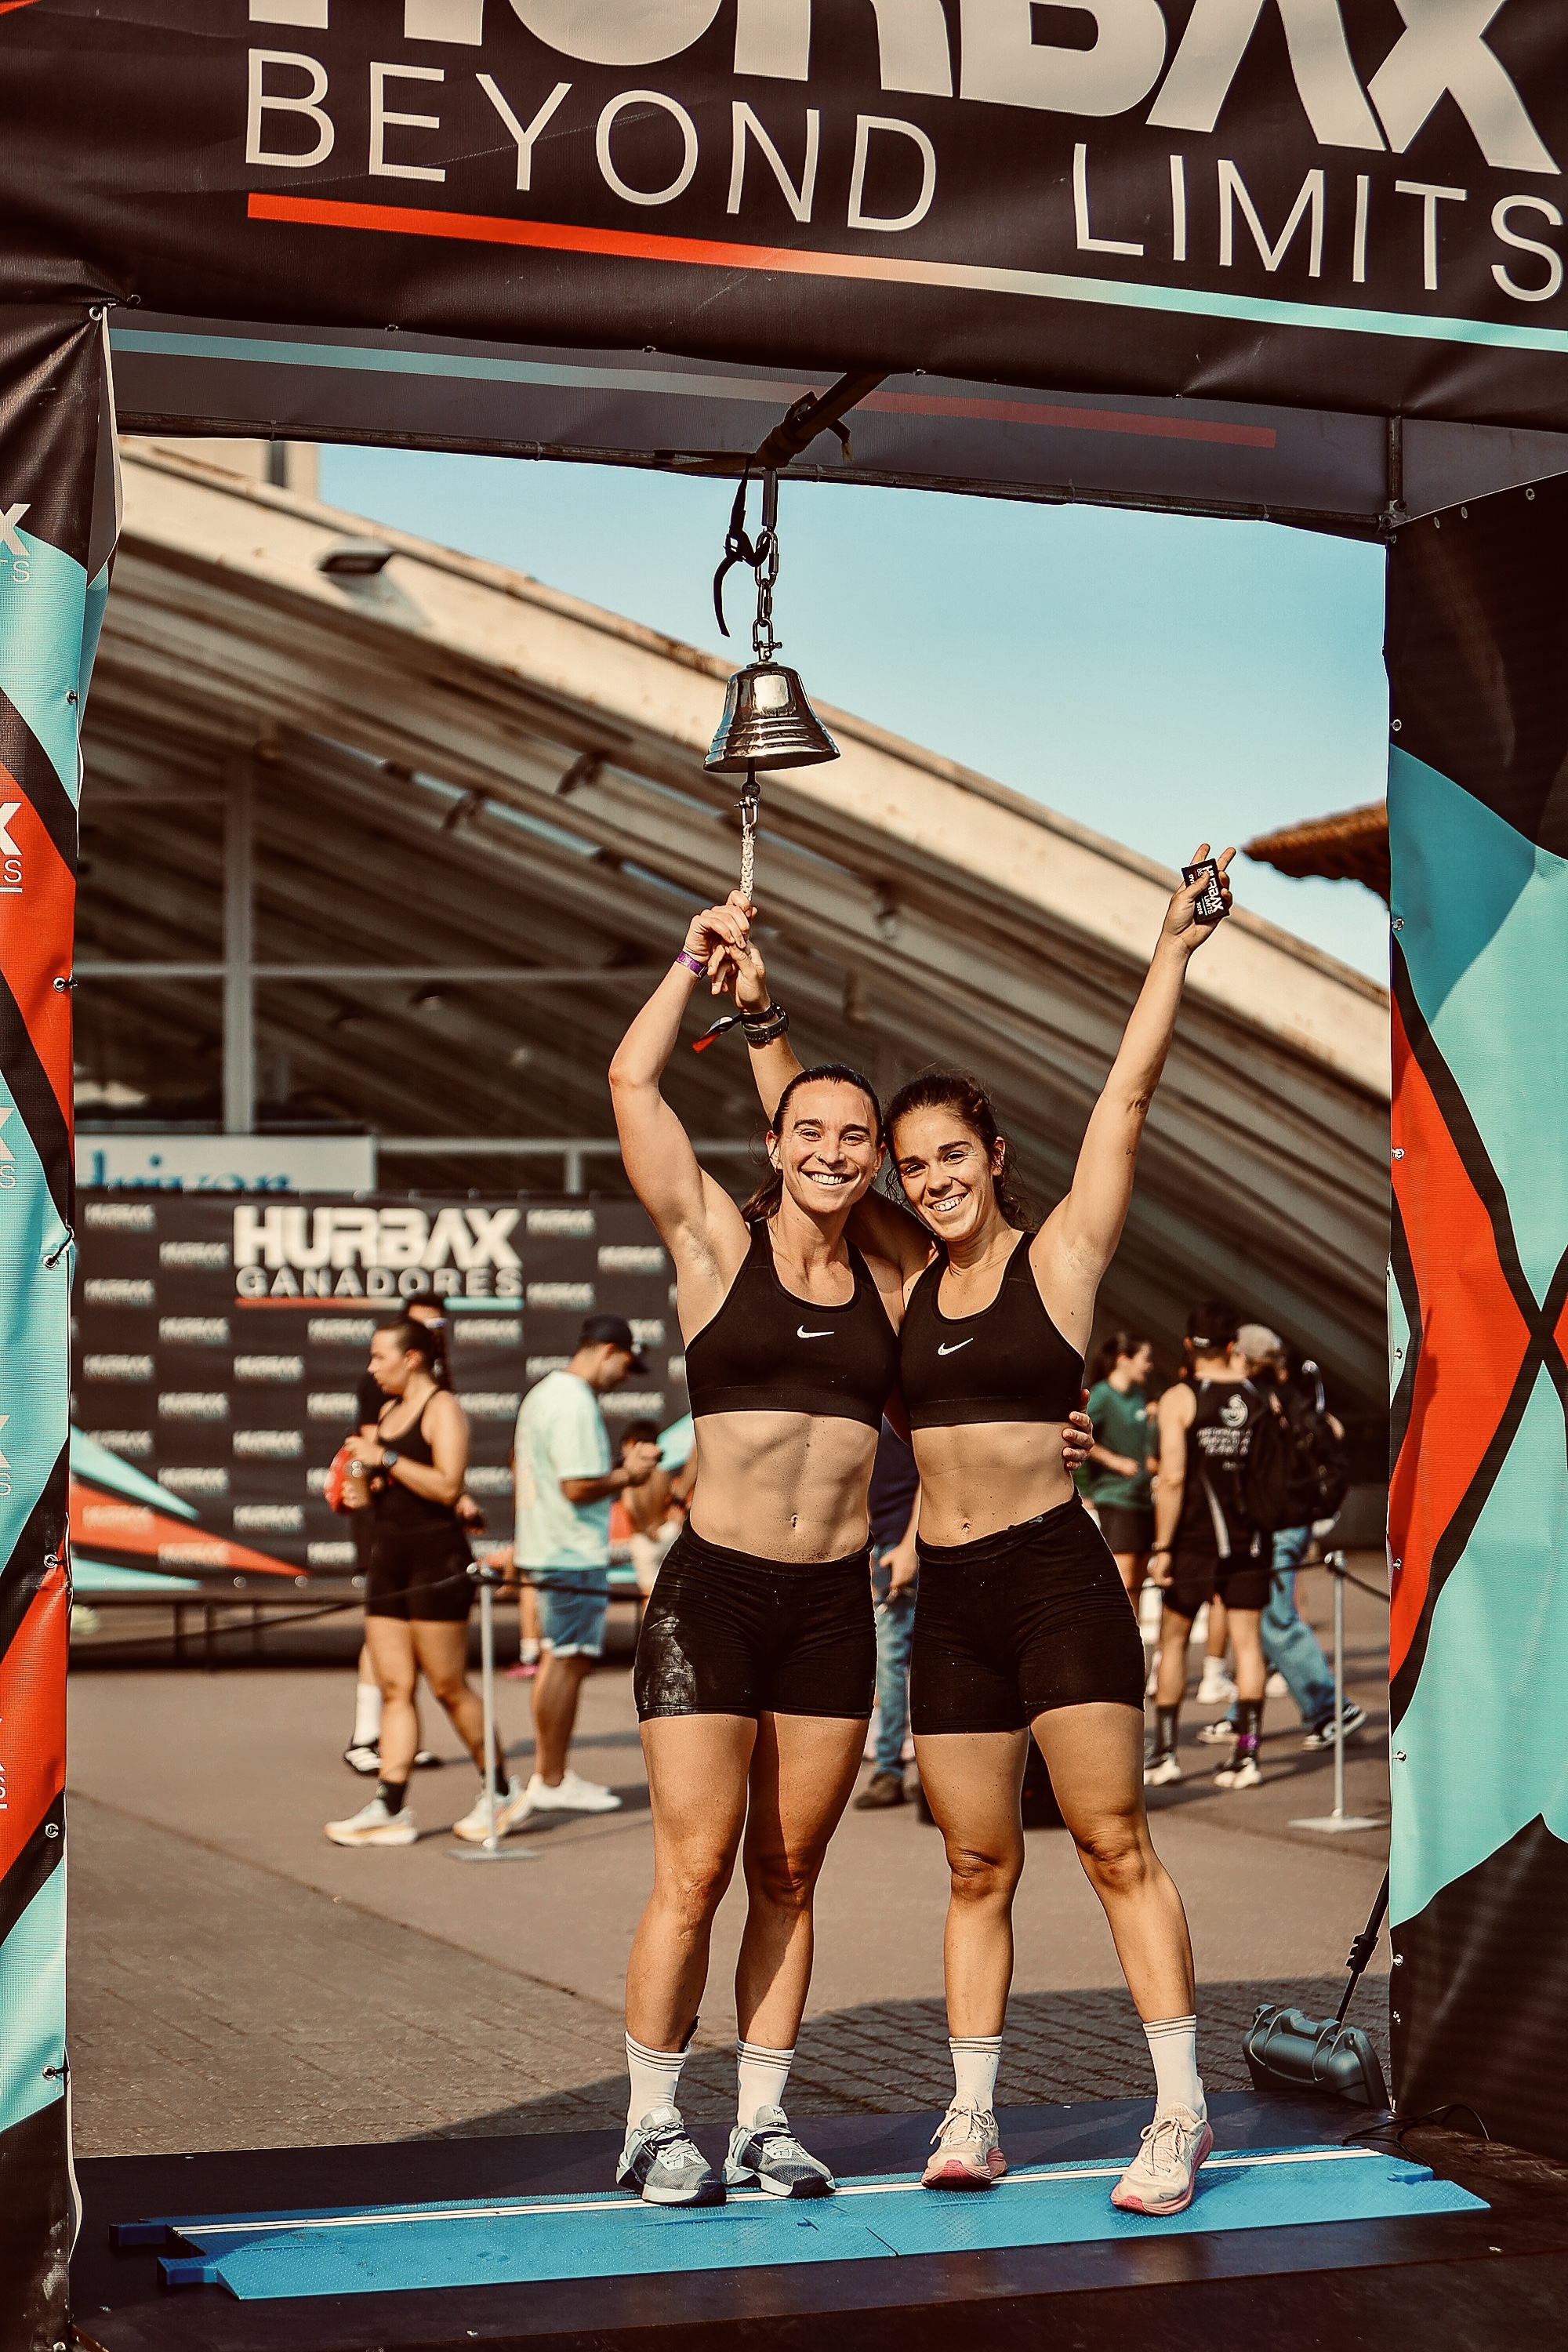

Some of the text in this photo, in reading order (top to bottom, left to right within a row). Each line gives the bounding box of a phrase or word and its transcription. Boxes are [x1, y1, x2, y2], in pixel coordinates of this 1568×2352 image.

[245, 48, 1564, 303] BEYOND LIMITS
[234, 1205, 522, 1271] HURBAX
[236, 1265, 523, 1299] GANADORES
